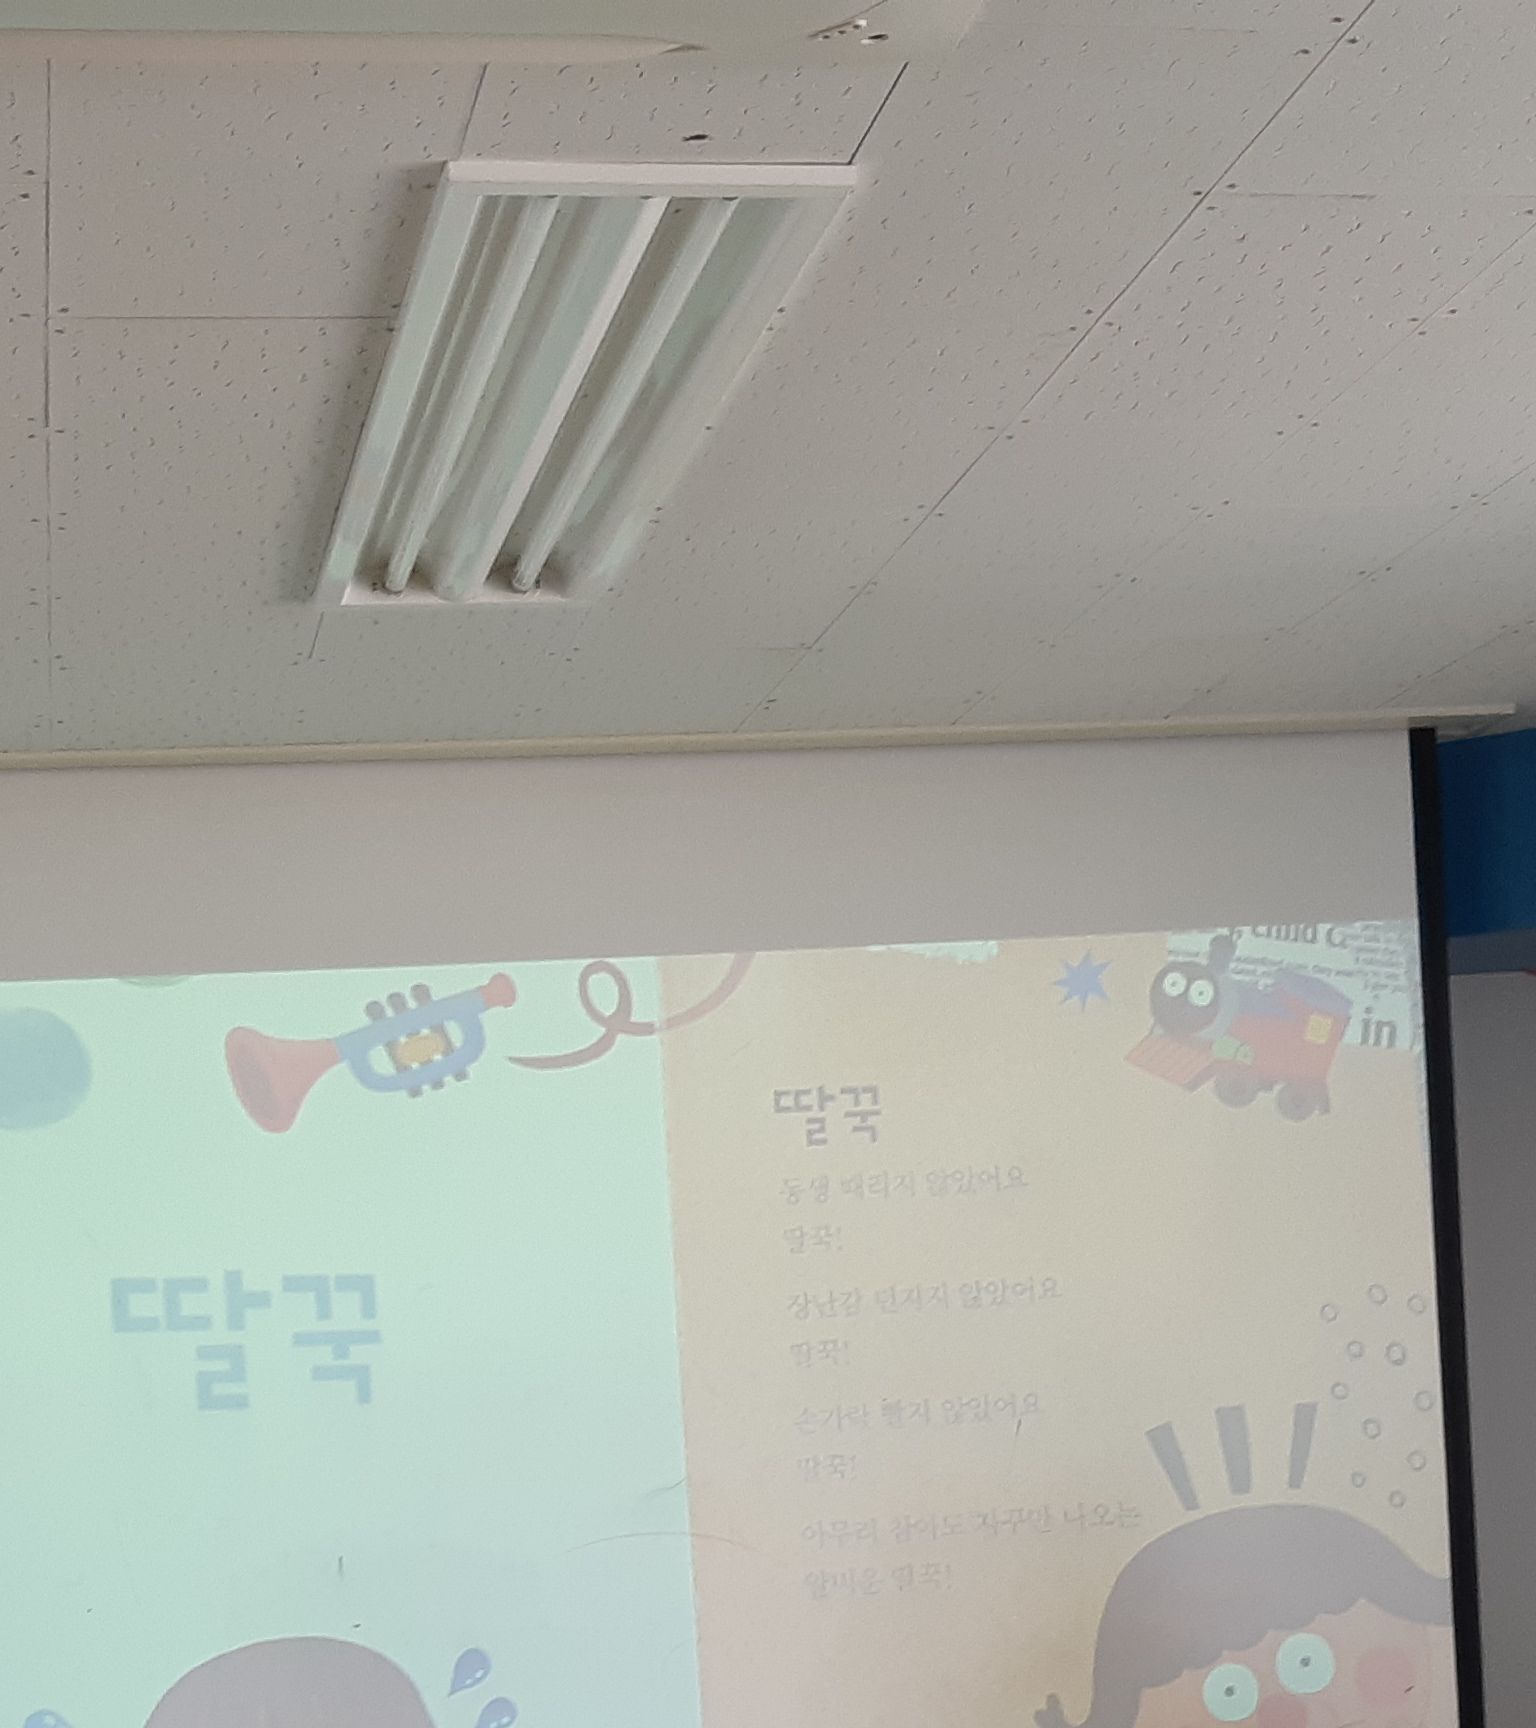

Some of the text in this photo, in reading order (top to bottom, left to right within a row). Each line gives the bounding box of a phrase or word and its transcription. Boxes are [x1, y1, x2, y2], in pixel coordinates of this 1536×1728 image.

[1360, 1006, 1397, 1048] in
[773, 1085, 882, 1147] 딸꾹
[111, 1269, 384, 1413] 딸꾹
